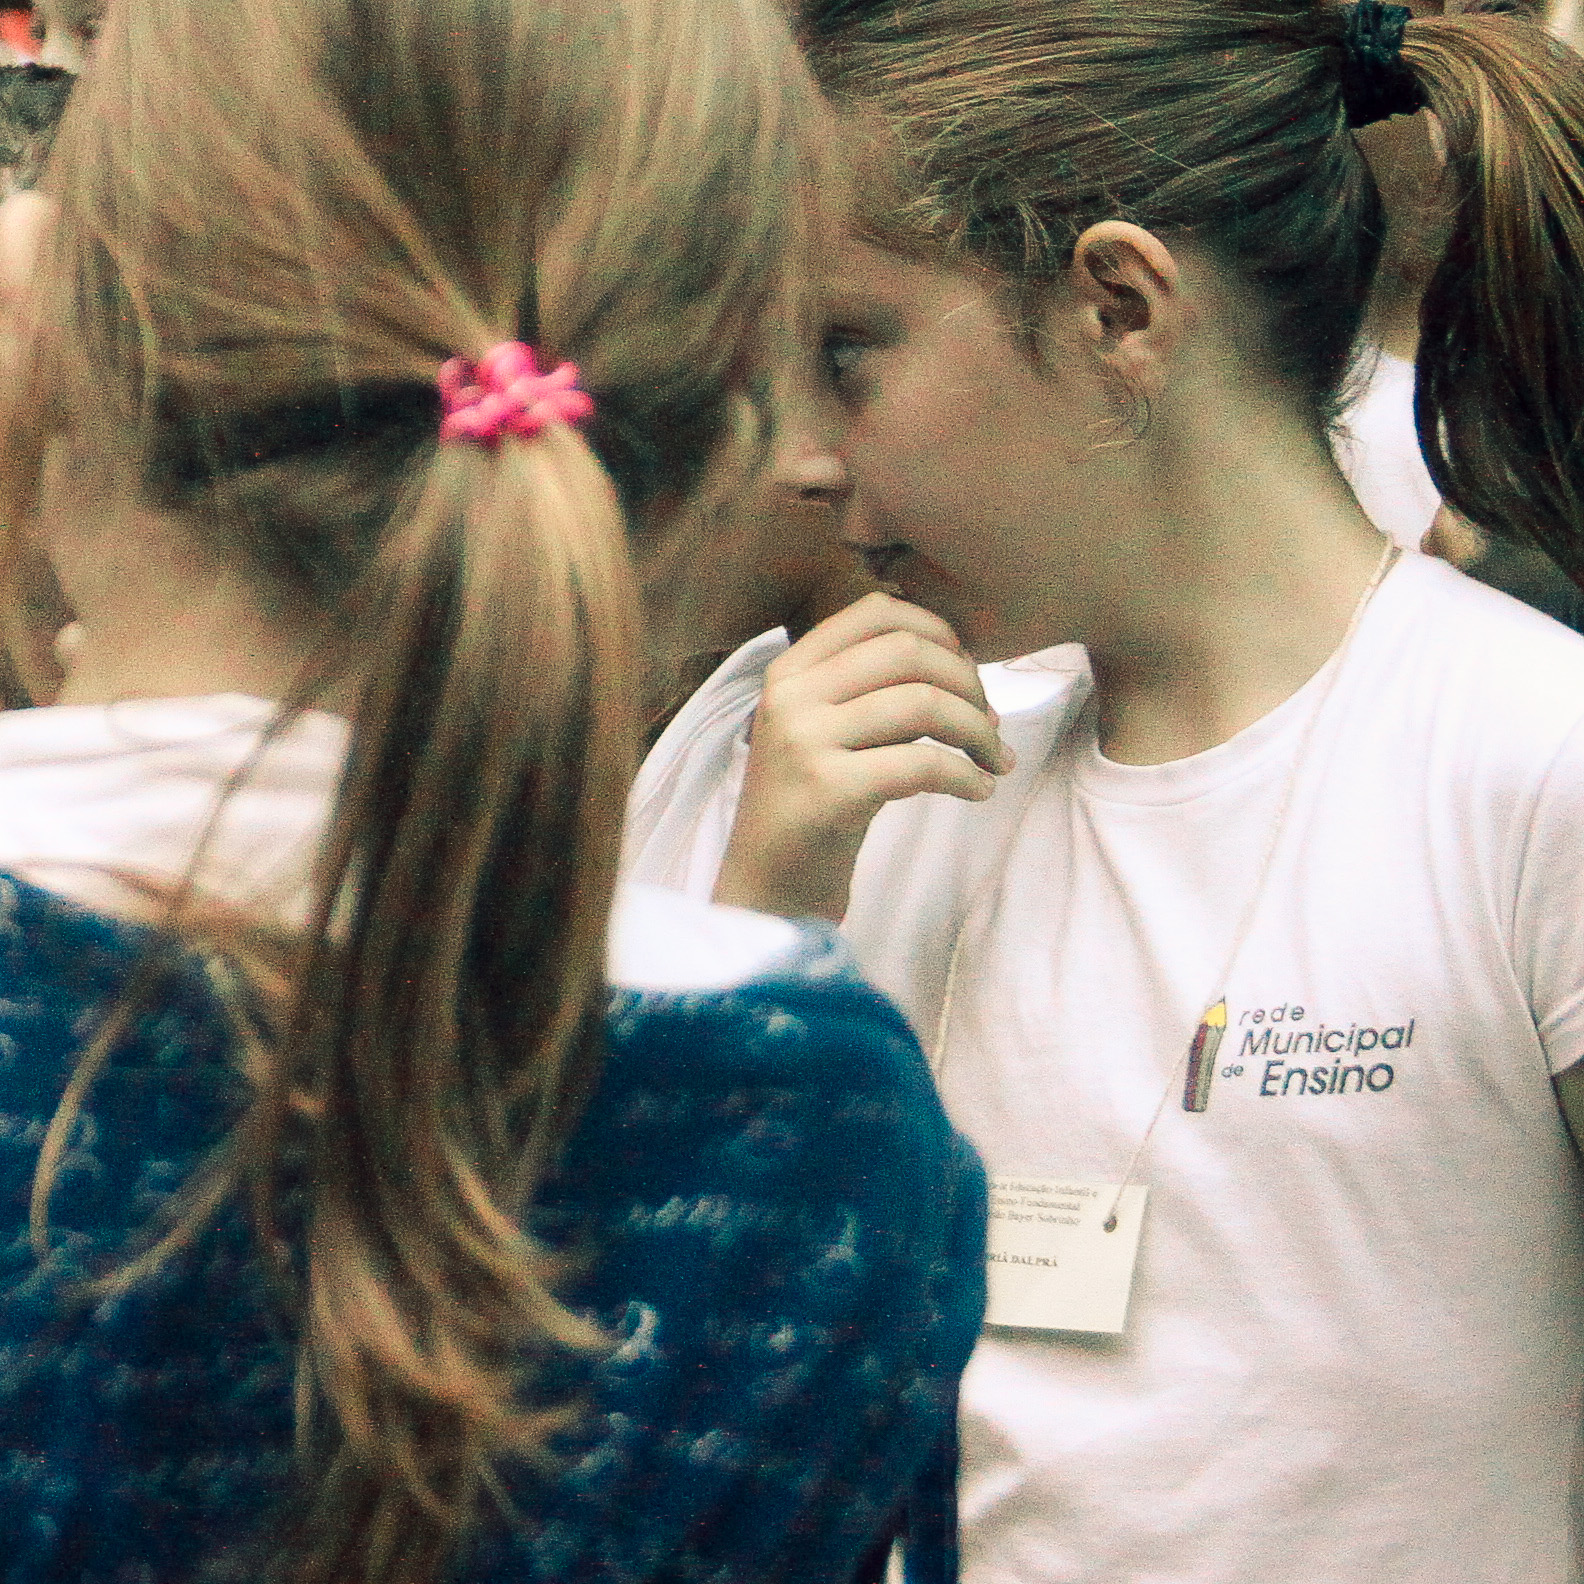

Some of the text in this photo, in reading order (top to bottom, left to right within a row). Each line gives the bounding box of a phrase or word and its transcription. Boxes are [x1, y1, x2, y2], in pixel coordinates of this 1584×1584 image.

[1239, 1002, 1305, 1025] rede
[1239, 1018, 1415, 1057] Municipal
[1221, 1057, 1394, 1096] de Ensino
